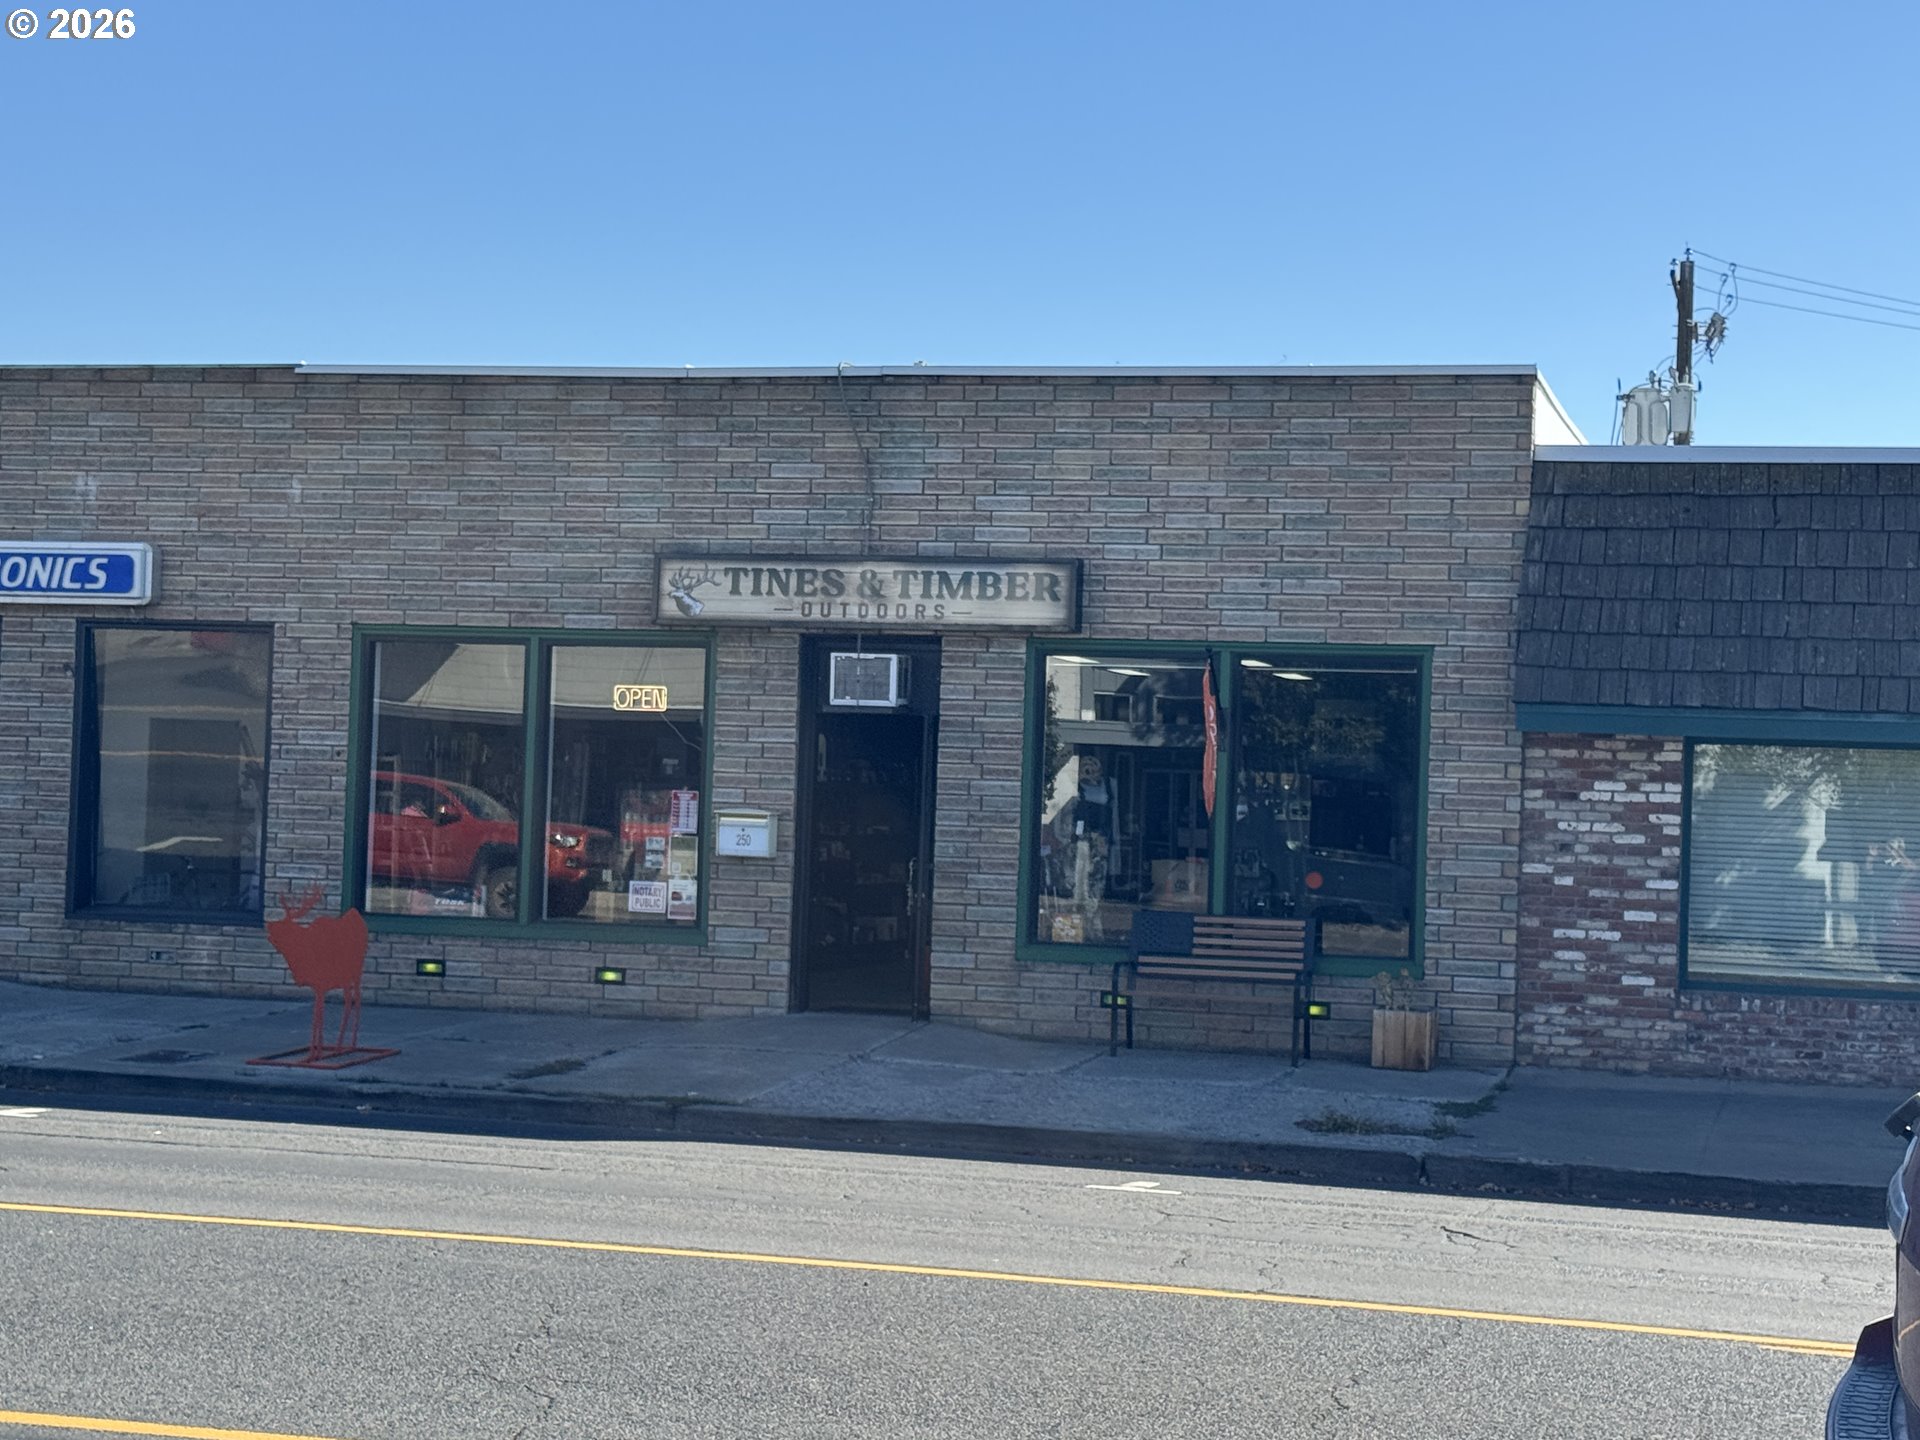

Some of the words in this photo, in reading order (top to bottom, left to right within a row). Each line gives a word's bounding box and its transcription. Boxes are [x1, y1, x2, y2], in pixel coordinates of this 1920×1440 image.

[0, 556, 109, 590] ONICS
[724, 566, 847, 598] TINES
[856, 568, 888, 599] &
[892, 569, 1062, 602] TIMBER
[801, 601, 945, 620] OUTDOORS
[616, 688, 666, 709] OPEN
[736, 834, 752, 847] 250
[634, 886, 664, 898] NOTARY
[634, 896, 662, 909] PUBLIC
